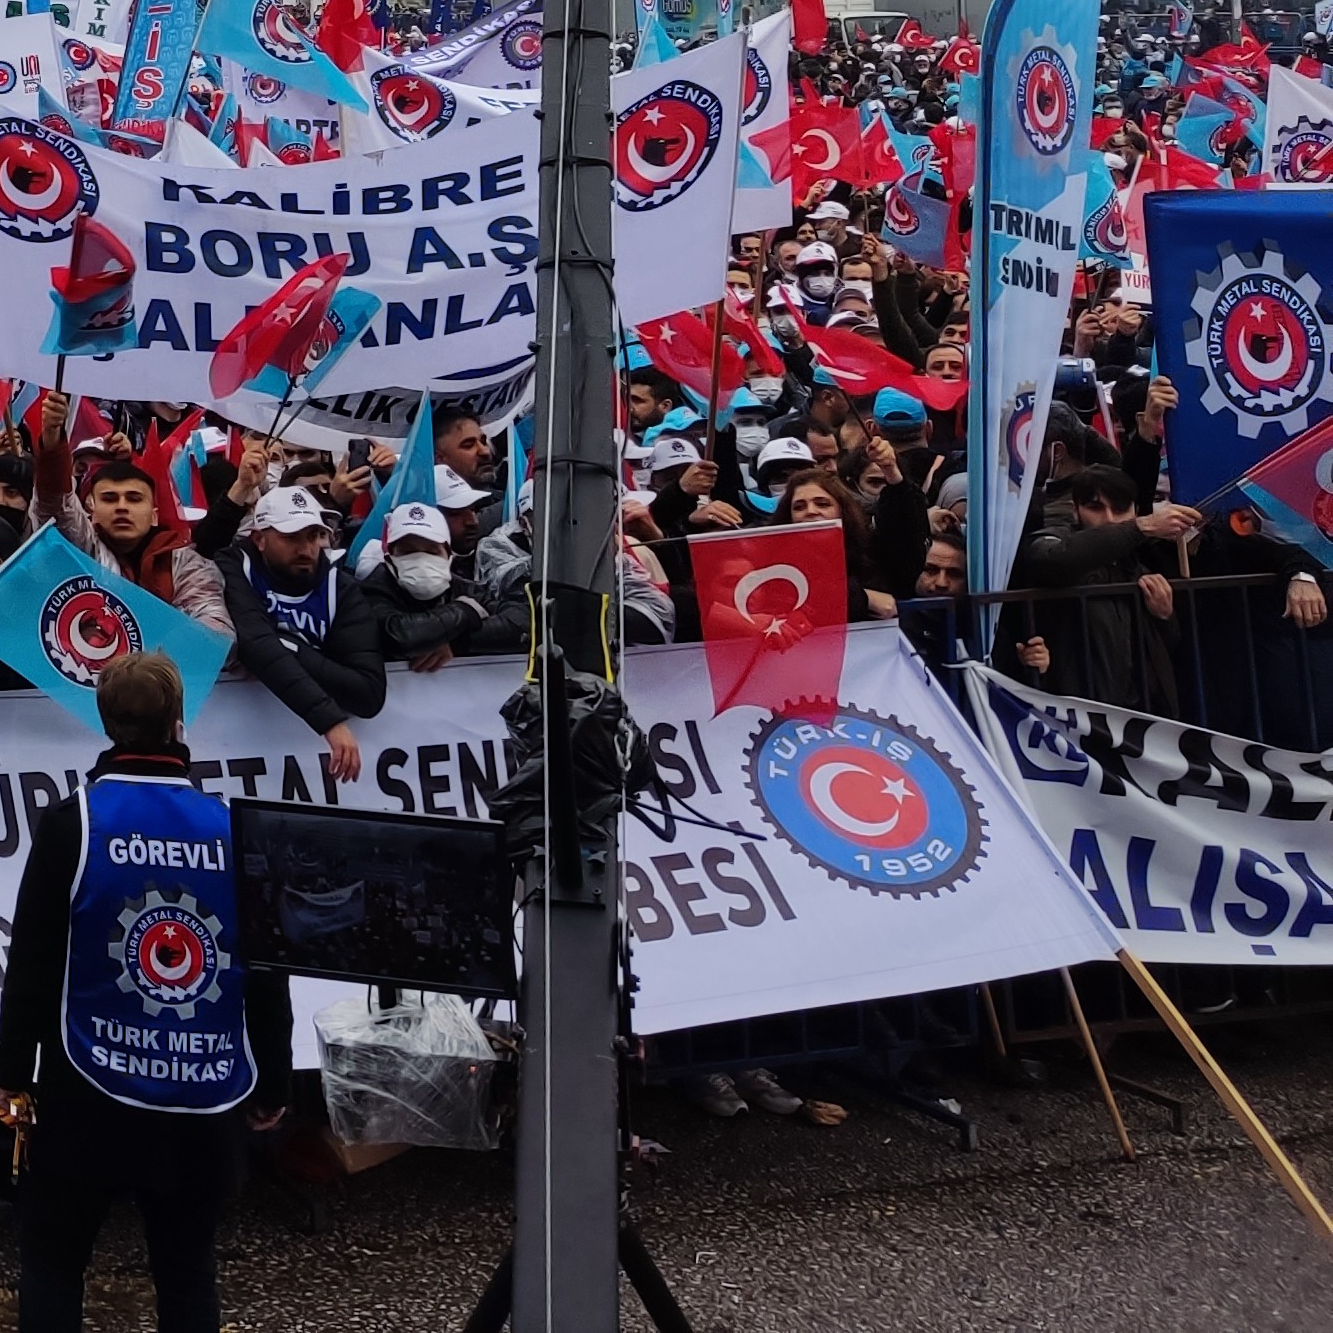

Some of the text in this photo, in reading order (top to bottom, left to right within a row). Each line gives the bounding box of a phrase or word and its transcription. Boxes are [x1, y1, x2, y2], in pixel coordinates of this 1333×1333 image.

[660, 84, 722, 140] SENDİKASI
[1017, 50, 1076, 122] TÜRK METAL SENDİKASI
[34, 127, 97, 197] SENDİKASI
[161, 154, 527, 217] KALİBRE
[1210, 279, 1323, 368] TÜRK METAL SENDİKASI
[47, 578, 77, 615] TÜRK
[769, 720, 914, 778] TÜRK-İŞ
[108, 832, 226, 872] GÖREVLİ
[853, 836, 953, 878] 1952
[128, 910, 216, 970] TÜRK METAL SENDİKASI
[90, 1016, 234, 1054] TÜRK METAL
[90, 1045, 235, 1084] SENDİKASI
